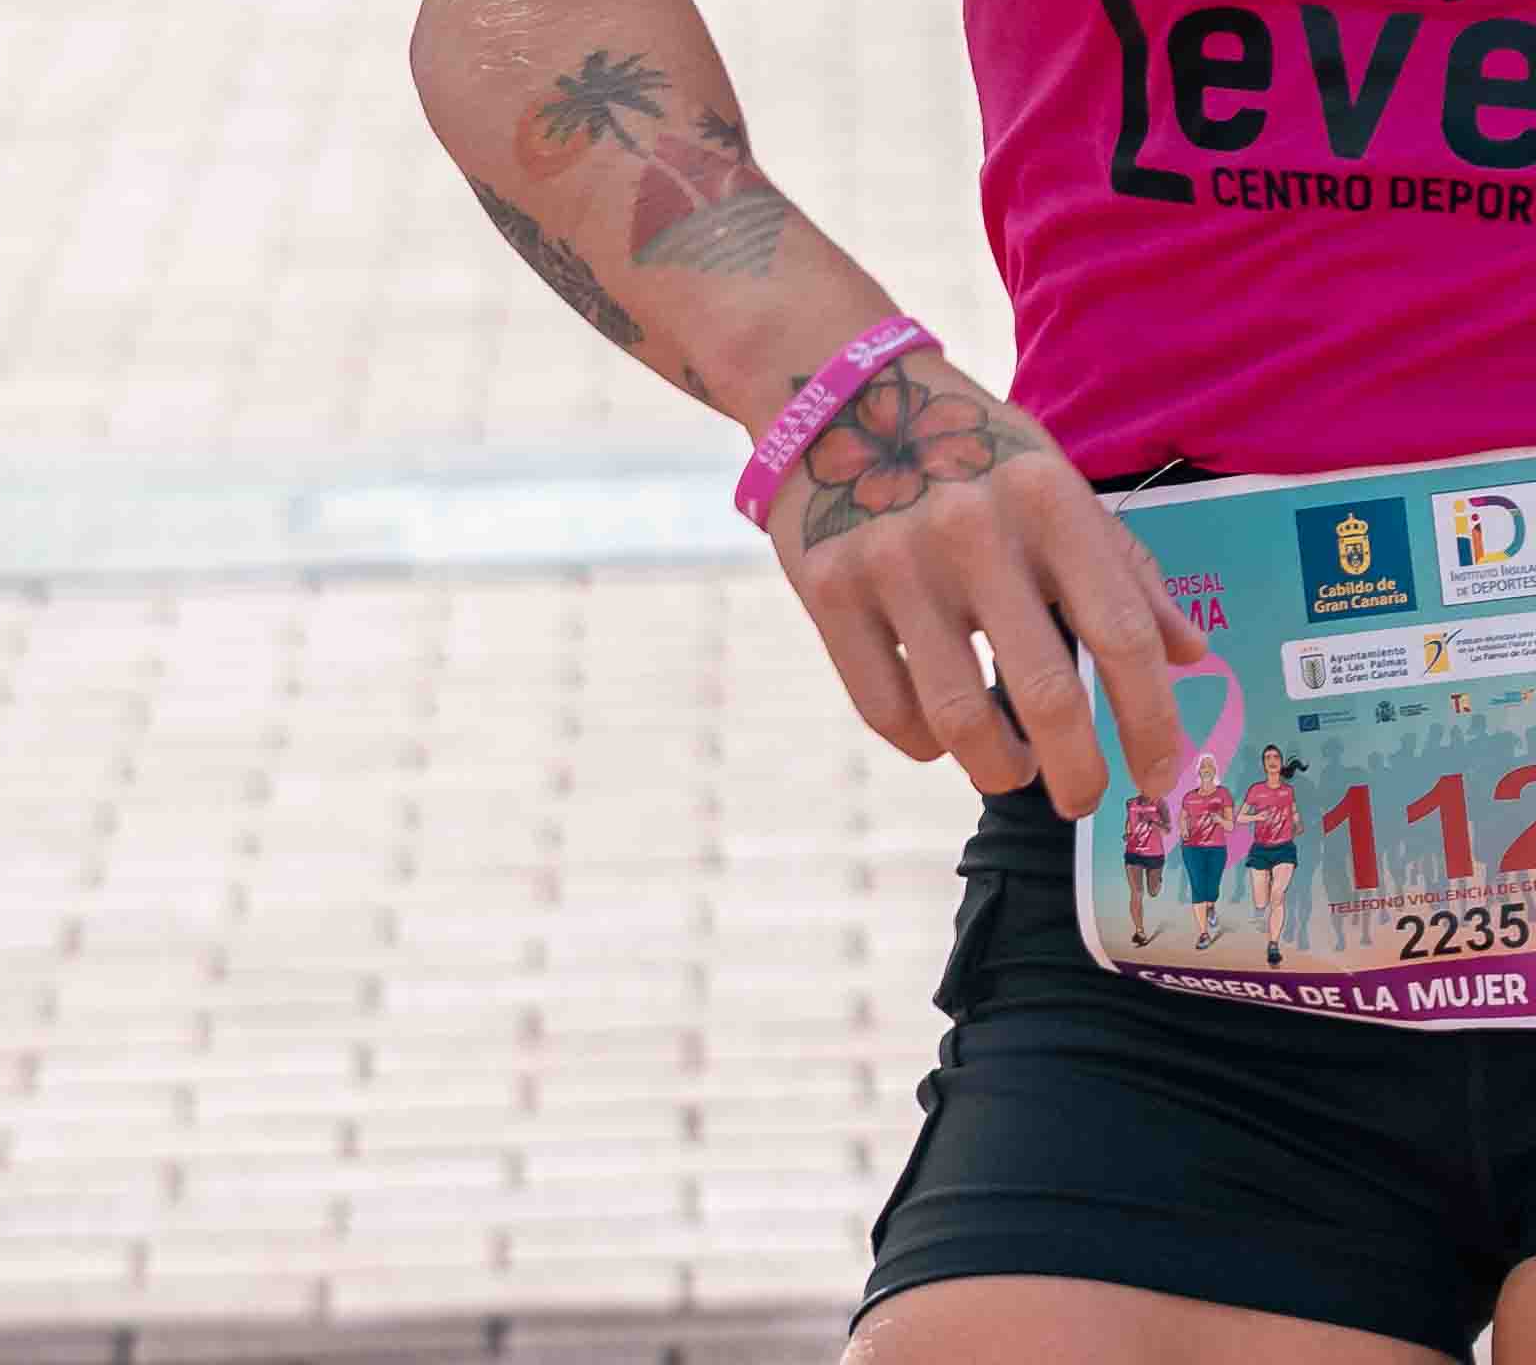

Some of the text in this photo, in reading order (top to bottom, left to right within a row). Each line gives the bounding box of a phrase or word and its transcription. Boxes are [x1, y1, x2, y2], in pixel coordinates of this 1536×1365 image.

[1210, 166, 1373, 211] CENTRO
[1319, 577, 1396, 598] Cabildo de
[1313, 591, 1408, 614] Gran Canaria
[1329, 646, 1407, 664] Ayuntamiento
[1406, 884, 1495, 908] VIOLENCIA
[1395, 901, 1531, 961] 2235
[1138, 969, 1294, 1004] CARRERA
[1299, 984, 1346, 1009] DE
[1353, 983, 1400, 1013] LA
[1406, 972, 1529, 1012] MUJER
